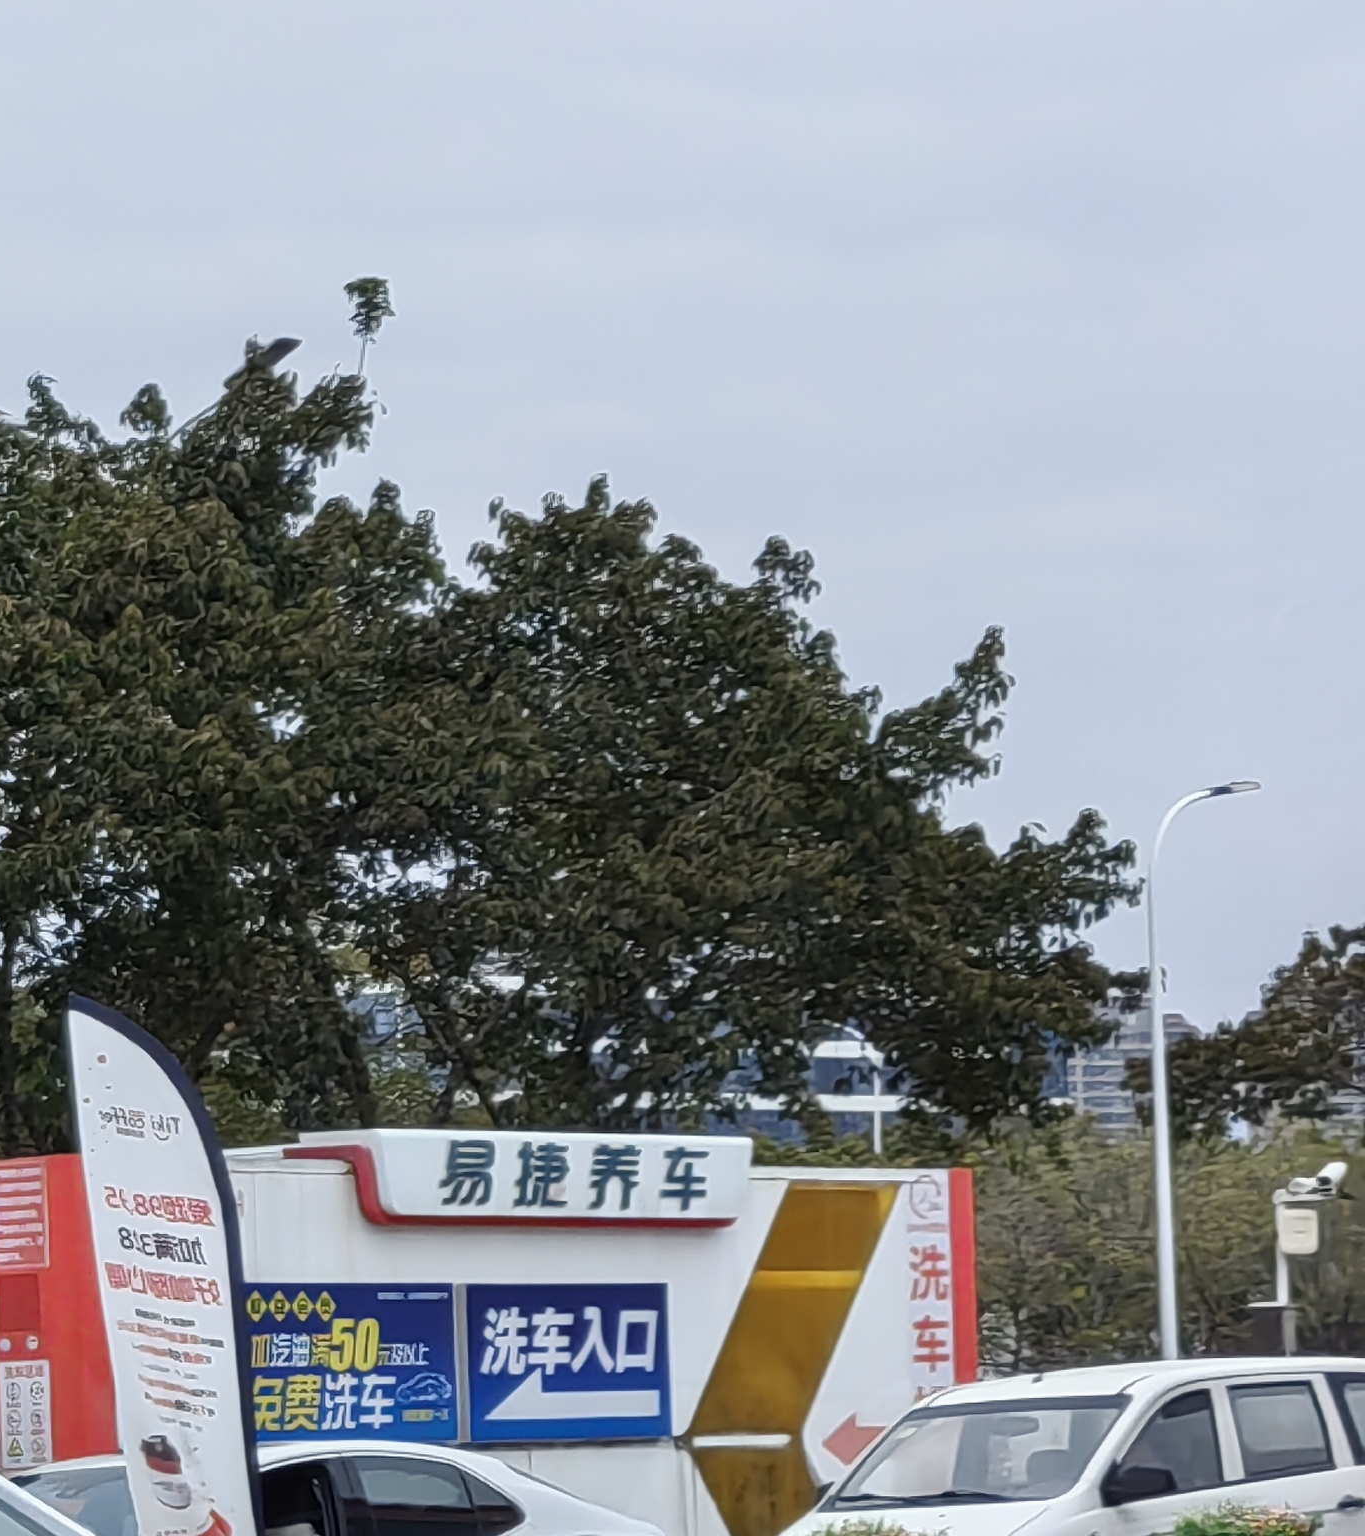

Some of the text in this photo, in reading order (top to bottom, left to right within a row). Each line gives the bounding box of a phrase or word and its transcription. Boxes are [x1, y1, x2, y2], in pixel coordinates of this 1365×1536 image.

[438, 1138, 712, 1211] 易捷养车
[479, 1306, 659, 1377] 洗车入口
[253, 1373, 396, 1431] 免费洗车
